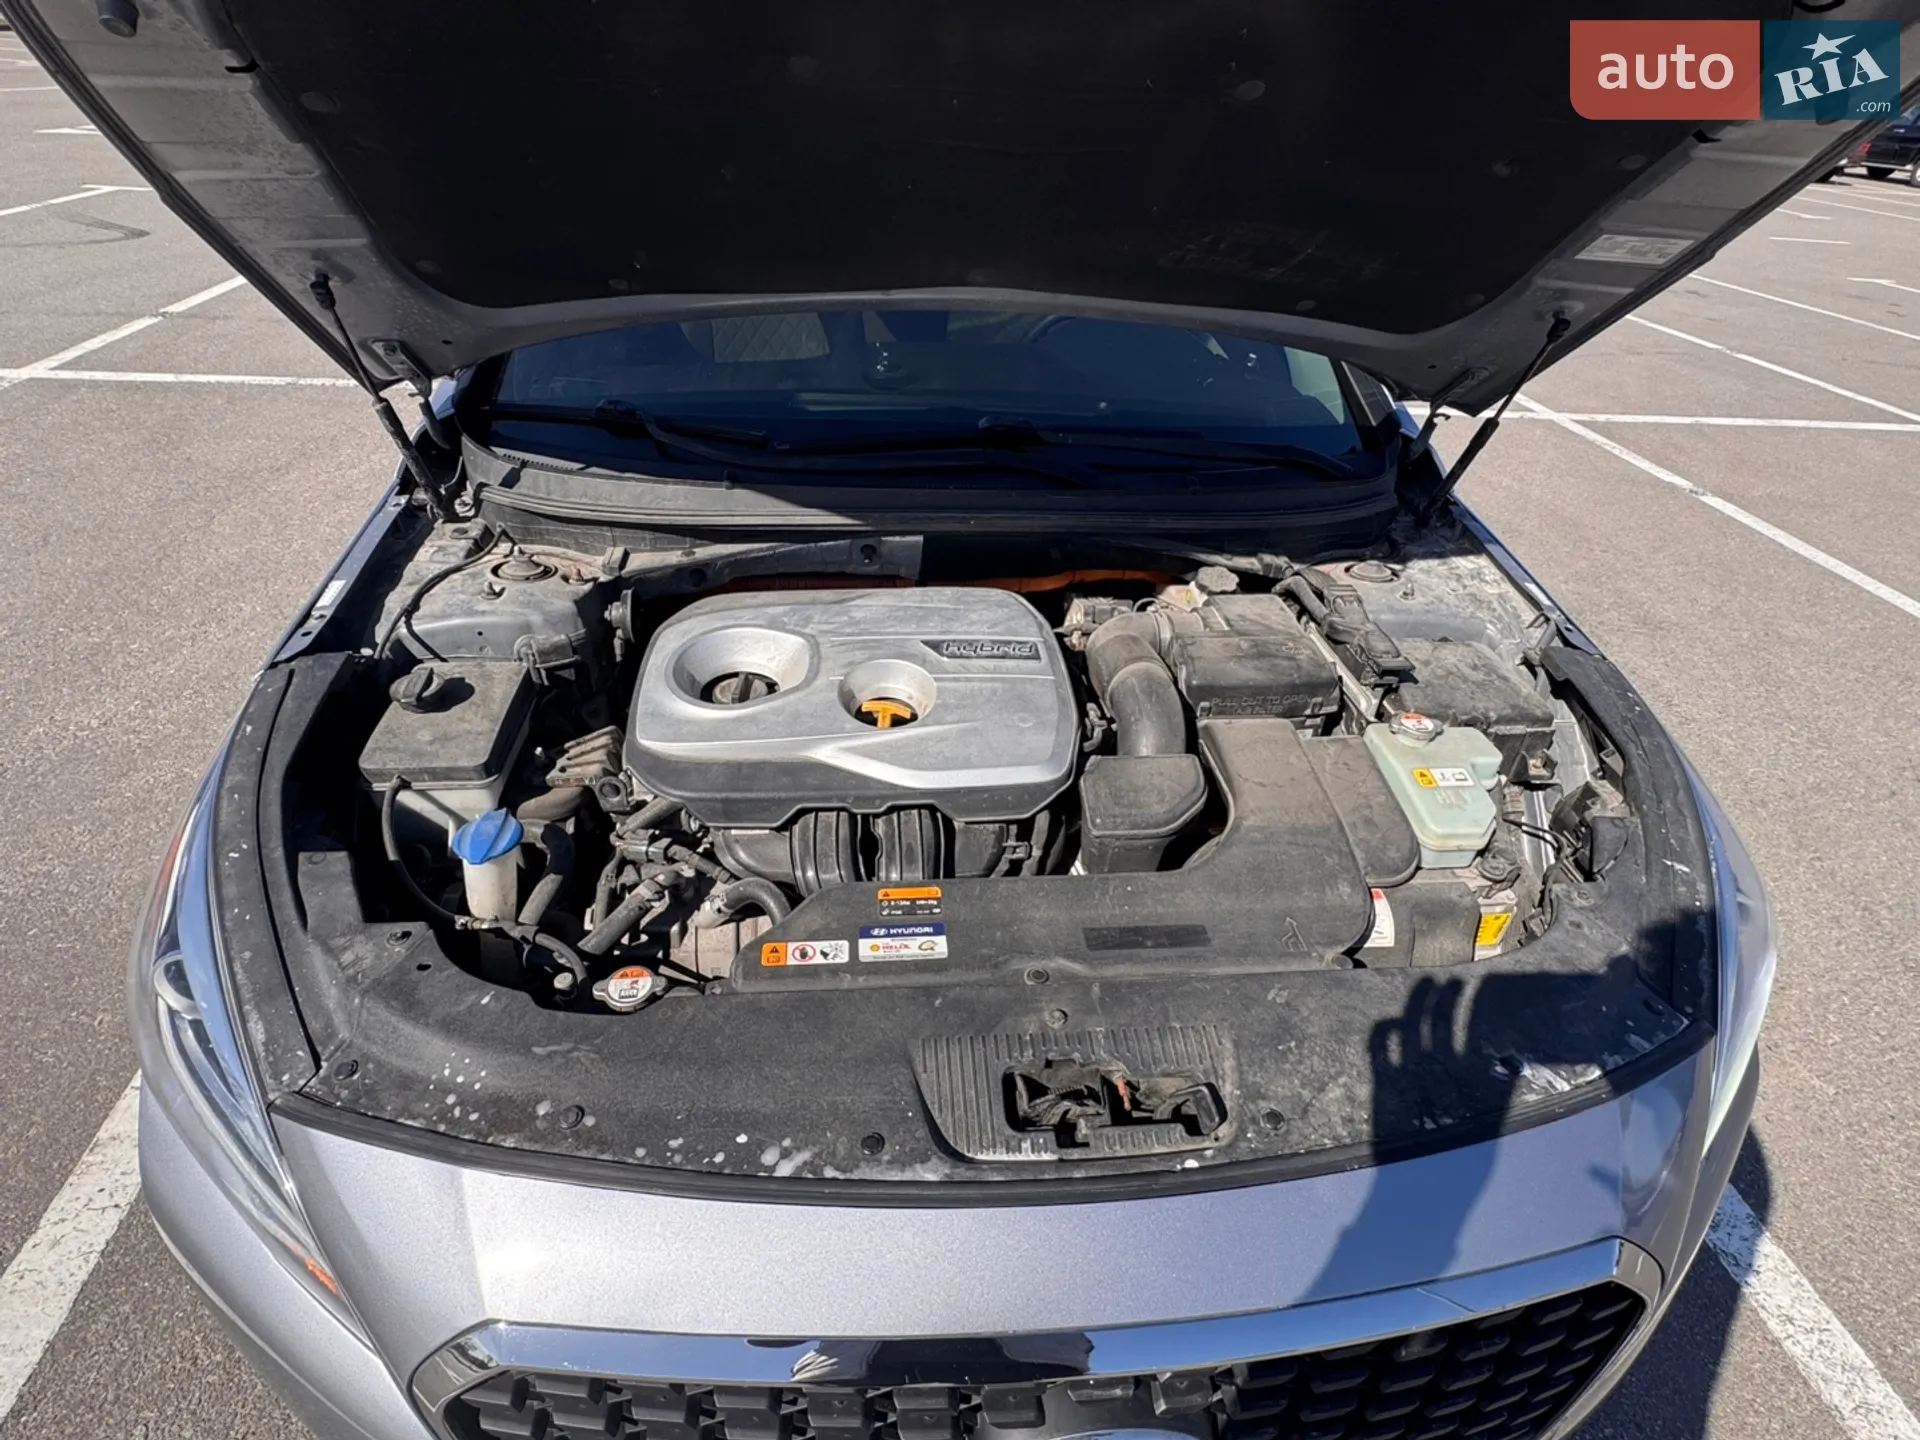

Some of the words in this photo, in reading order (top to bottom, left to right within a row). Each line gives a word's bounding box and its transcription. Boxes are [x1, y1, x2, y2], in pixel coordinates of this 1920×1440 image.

[943, 641, 1035, 656] hybrid
[1241, 696, 1264, 705] OUT
[1267, 695, 1280, 704] TO
[1282, 694, 1312, 704] OPEN
[889, 926, 934, 935] HYUNDAI
